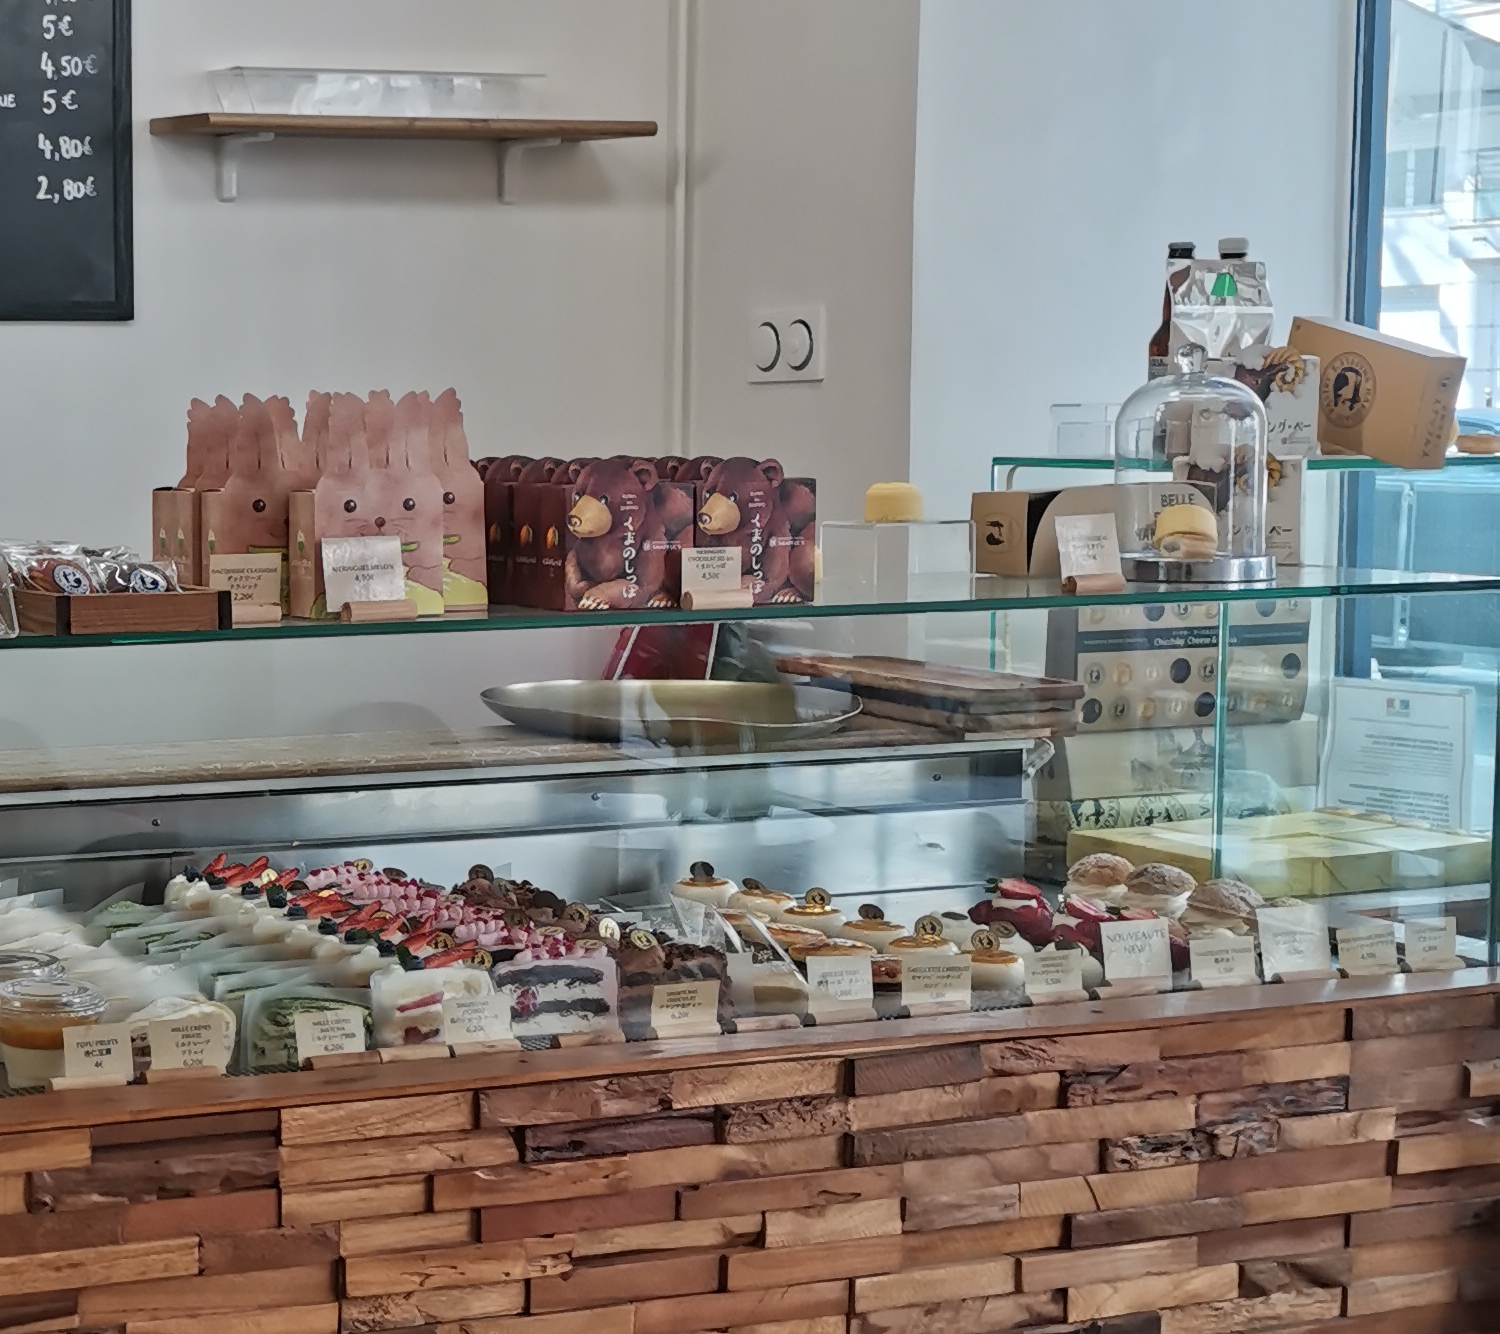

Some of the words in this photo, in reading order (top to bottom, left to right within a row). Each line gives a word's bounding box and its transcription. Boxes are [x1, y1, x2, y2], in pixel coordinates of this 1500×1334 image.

[42, 14, 74, 40] 5€
[40, 51, 99, 81] 4,50€
[37, 132, 93, 162] 4,80€
[35, 175, 98, 204] 2,80€
[1160, 492, 1197, 508] BELLE
[622, 515, 641, 599] くまのしっぽ
